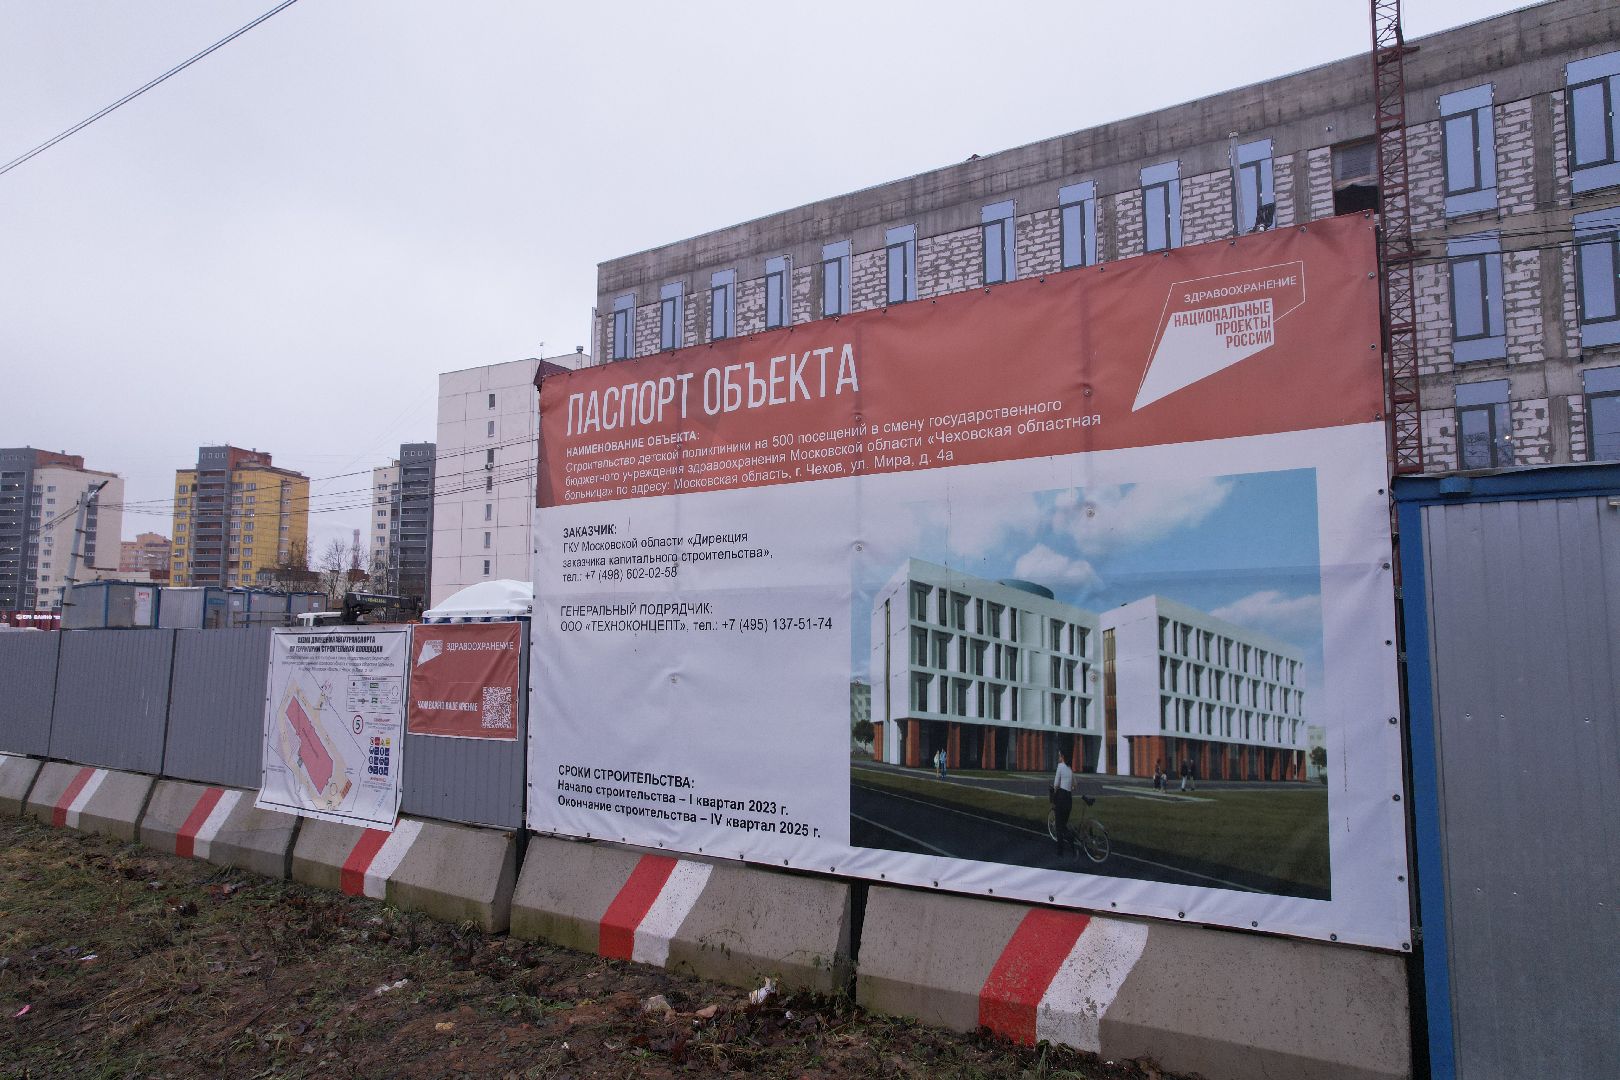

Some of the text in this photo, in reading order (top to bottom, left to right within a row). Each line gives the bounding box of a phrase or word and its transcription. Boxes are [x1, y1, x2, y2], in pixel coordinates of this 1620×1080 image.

[1184, 276, 1296, 304] ЗДРАВООХРАНЕНИЕ
[1174, 300, 1270, 327] НАЦИОНАЛЬНЫЕ
[1215, 315, 1271, 336] ПРОЕКТЫ
[1226, 330, 1272, 348] РОССИИ
[566, 344, 859, 436] ПАСПОРТ ОБЪЕКТА
[566, 400, 1062, 472] Строительство детской поликлиники на 500 посещений в смену государственного
[566, 430, 700, 457] НАИМЕНОВАНИЕ ОБЪЕКТА:
[566, 414, 1101, 486] бюджетного учреждения здравоохранения Московской области «Чеховская областная
[564, 489, 612, 500] больница»
[616, 486, 628, 495] по
[630, 482, 670, 496] адресу:
[674, 474, 738, 490] Московская
[742, 470, 792, 483] область,
[806, 462, 846, 476] Чехов,
[850, 458, 868, 474] ул.
[874, 453, 914, 470] Мира,
[919, 452, 932, 466] д.
[936, 450, 954, 462] 4а
[563, 524, 617, 538] ЗАКАЗЧИК:
[564, 532, 748, 554] ГКУ Московской области «Дирекция
[562, 548, 773, 568] заказчика капитального строительства»,
[562, 566, 678, 583] тел.: +7 (498) 602-02-58
[560, 602, 713, 617] ГЕНЕРАЛЬНЫЙ ПОДРЯДЧИК:
[560, 620, 582, 632] ООО
[694, 620, 718, 632] тел.:
[722, 618, 736, 630] +7
[739, 618, 768, 634] (495)
[773, 617, 832, 630] 137-51-74
[446, 642, 514, 652] ЗДРАВООХРАНЕНИЕ
[356, 720, 360, 730] 5
[558, 764, 694, 788] СРОКИ СТРОИТЕЛЬСТВА:
[558, 780, 592, 794] Начало
[596, 786, 676, 804] строительства
[696, 797, 744, 812] квартал
[748, 800, 777, 814] 2023
[780, 804, 788, 816] г.
[558, 795, 612, 812] Окончание
[614, 804, 696, 822] строительства
[710, 814, 722, 826] IV
[726, 818, 776, 832] квартал
[780, 822, 809, 836] 2025
[813, 827, 820, 838] г.
